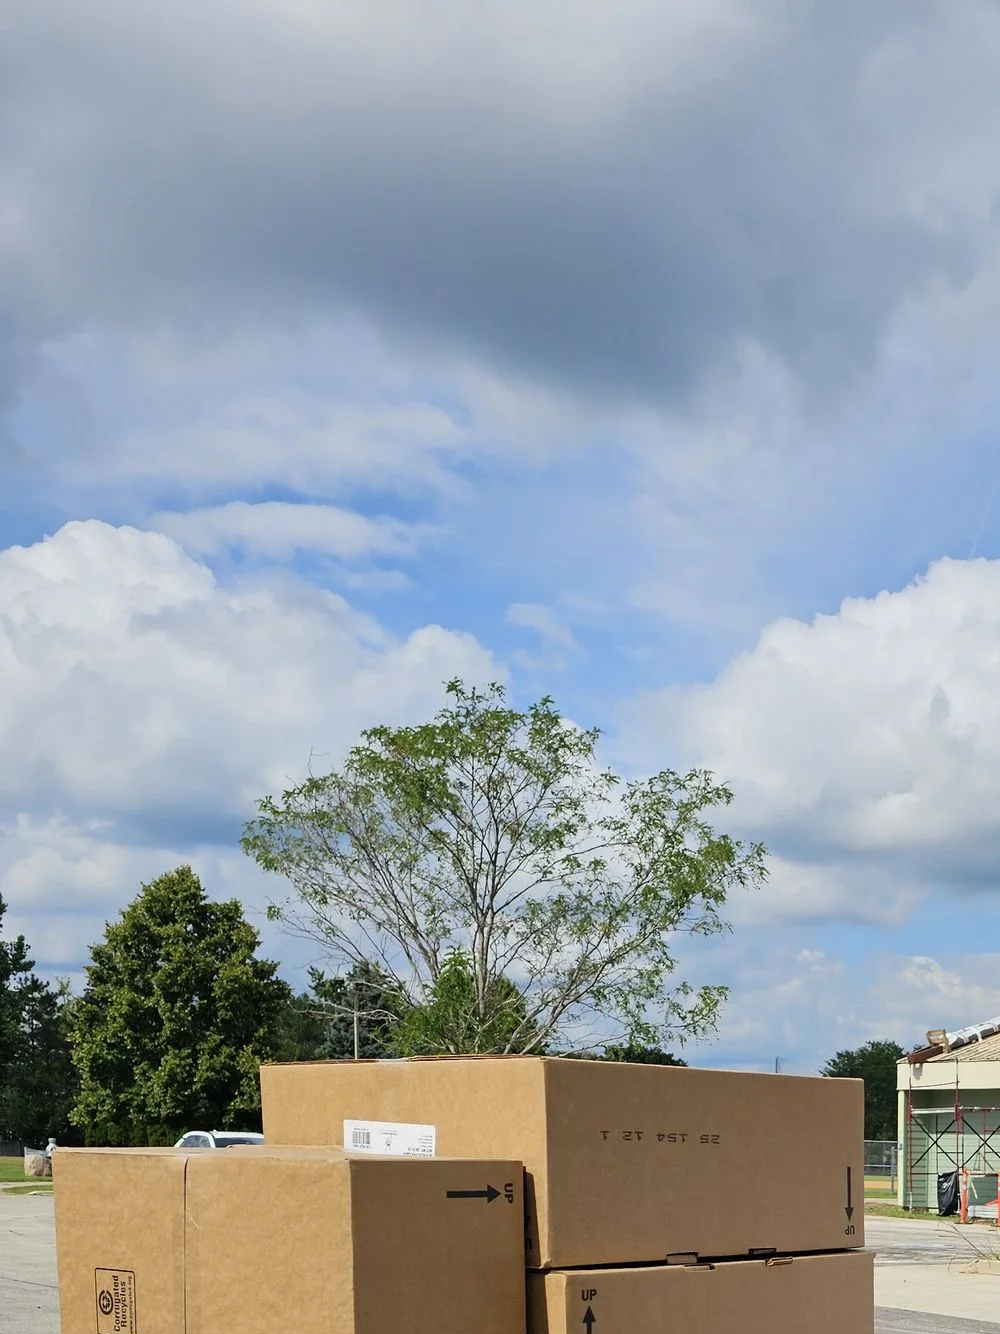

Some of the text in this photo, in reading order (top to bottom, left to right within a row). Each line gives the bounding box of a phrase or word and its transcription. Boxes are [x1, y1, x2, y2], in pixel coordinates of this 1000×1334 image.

[600, 1131, 720, 1144] 25 154 12 1
[505, 1183, 513, 1204] UP
[845, 1225, 855, 1235] UP
[582, 1289, 597, 1301] UP
[112, 1275, 121, 1332] Corrugated
